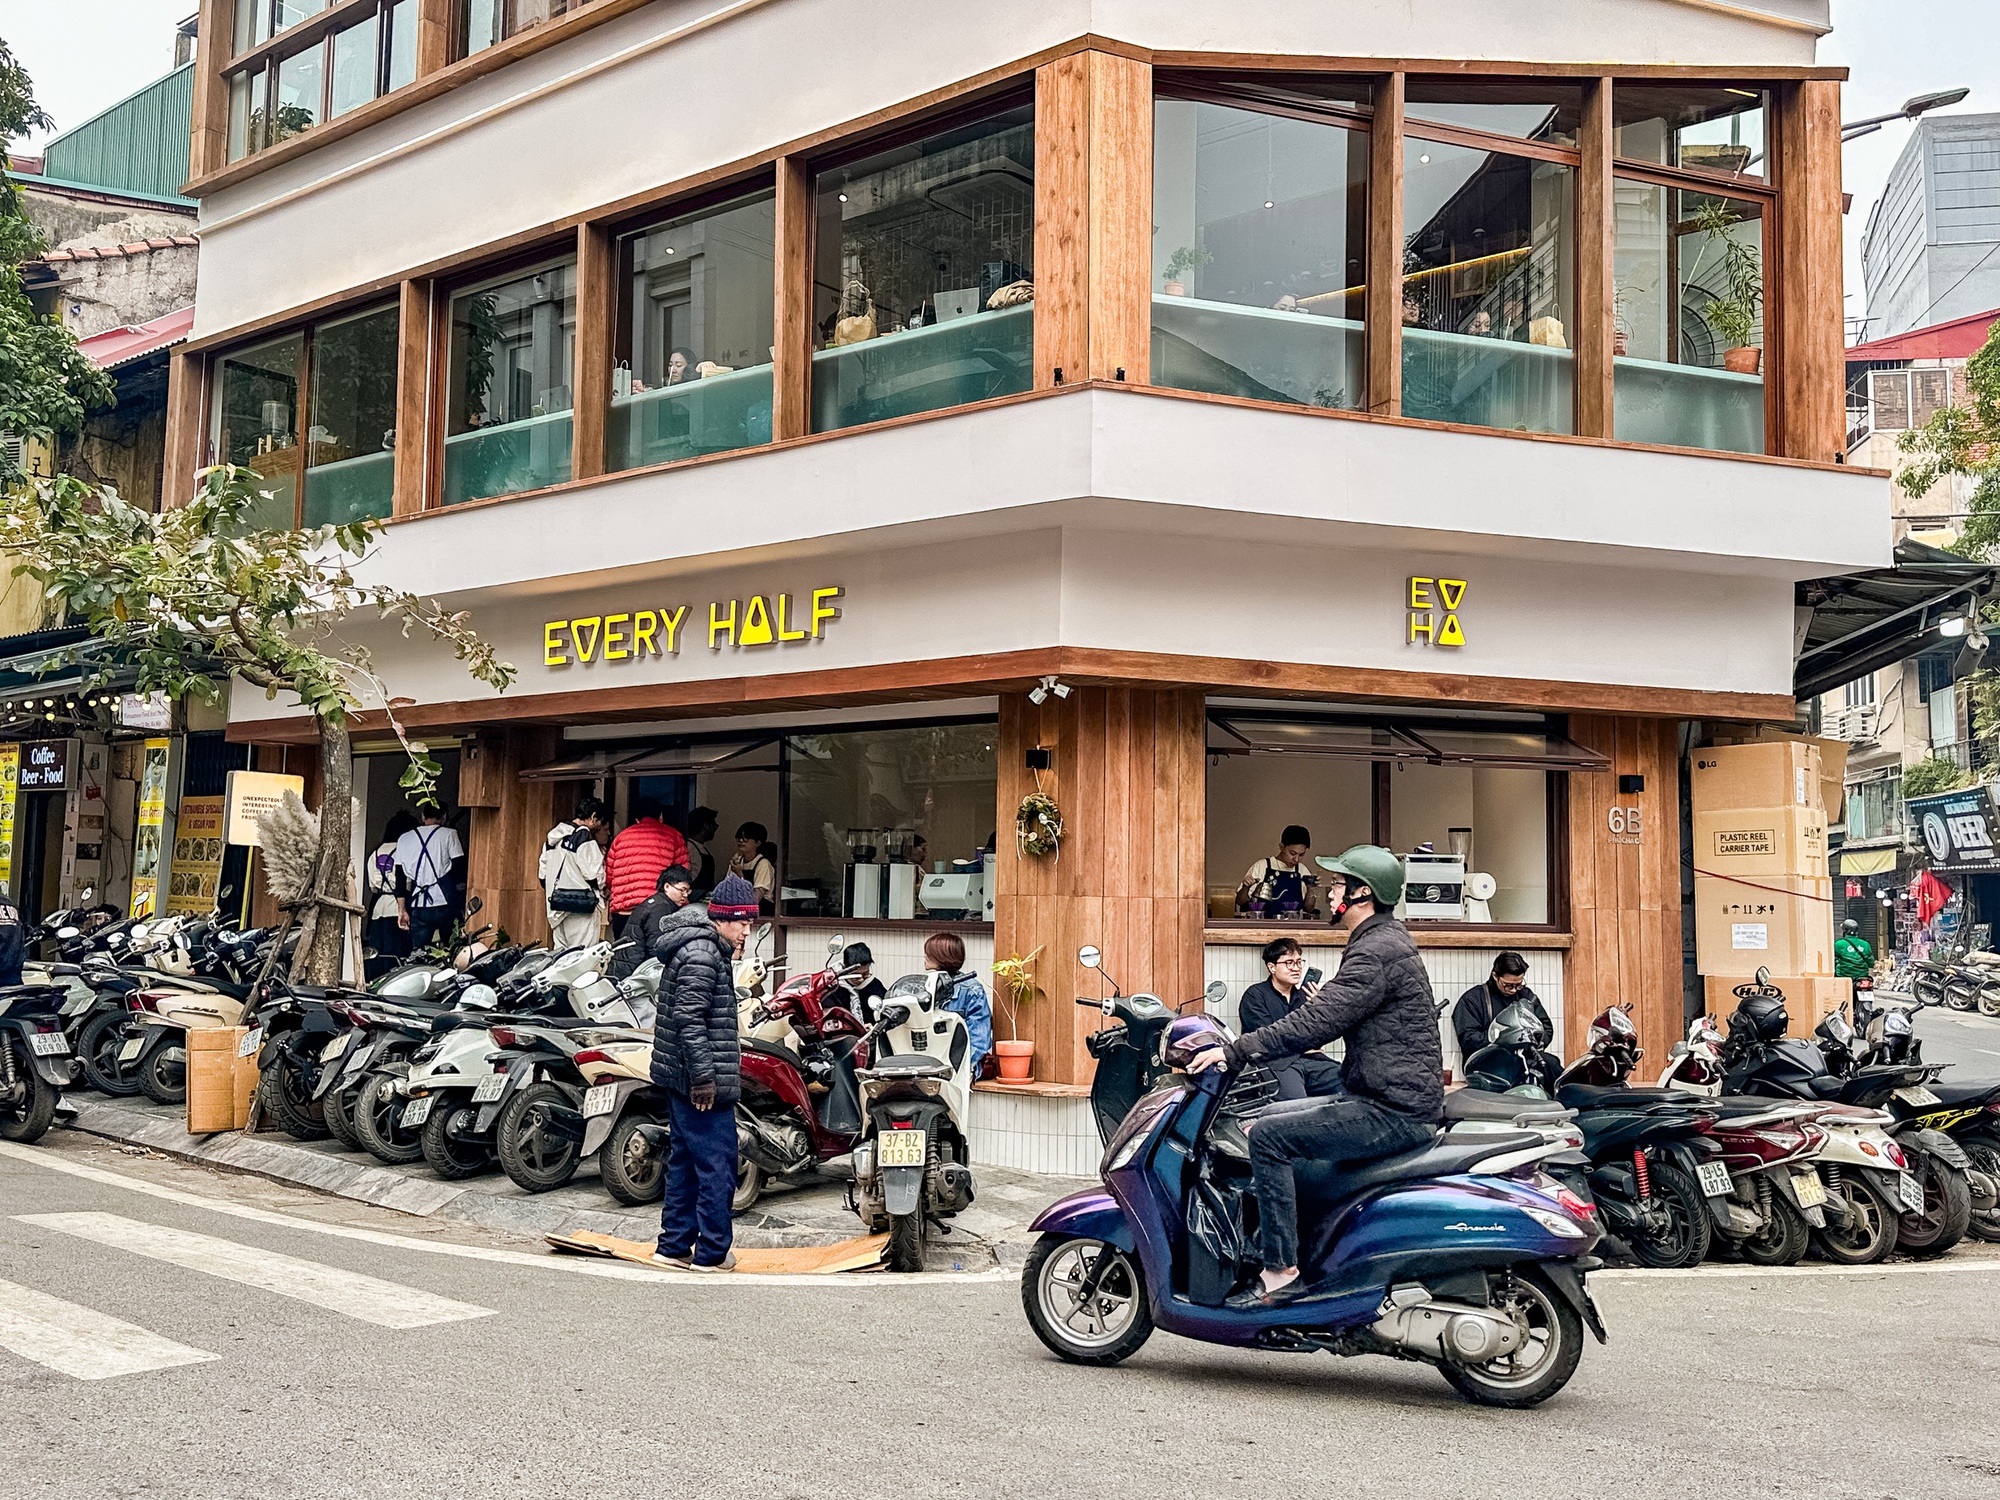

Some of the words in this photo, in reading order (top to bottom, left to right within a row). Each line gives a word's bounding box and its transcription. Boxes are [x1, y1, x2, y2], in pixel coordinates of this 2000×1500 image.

[543, 605, 692, 666] EVERY
[708, 586, 845, 650] HALF
[31, 747, 56, 764] Coffee
[21, 768, 39, 785] Beer
[44, 765, 64, 784] Food
[1608, 806, 1644, 834] 6B
[1720, 833, 1748, 842] PLASTIC
[1749, 832, 1768, 841] REEL
[1946, 814, 1994, 849] BEER
[1720, 845, 1750, 853] CARRIER
[1751, 844, 1769, 852] TAPE
[885, 1133, 918, 1147] 37-B2
[881, 1149, 922, 1164] 813.63
[1701, 1163, 1724, 1180] 29-L5
[1704, 1178, 1732, 1194] 487.93
